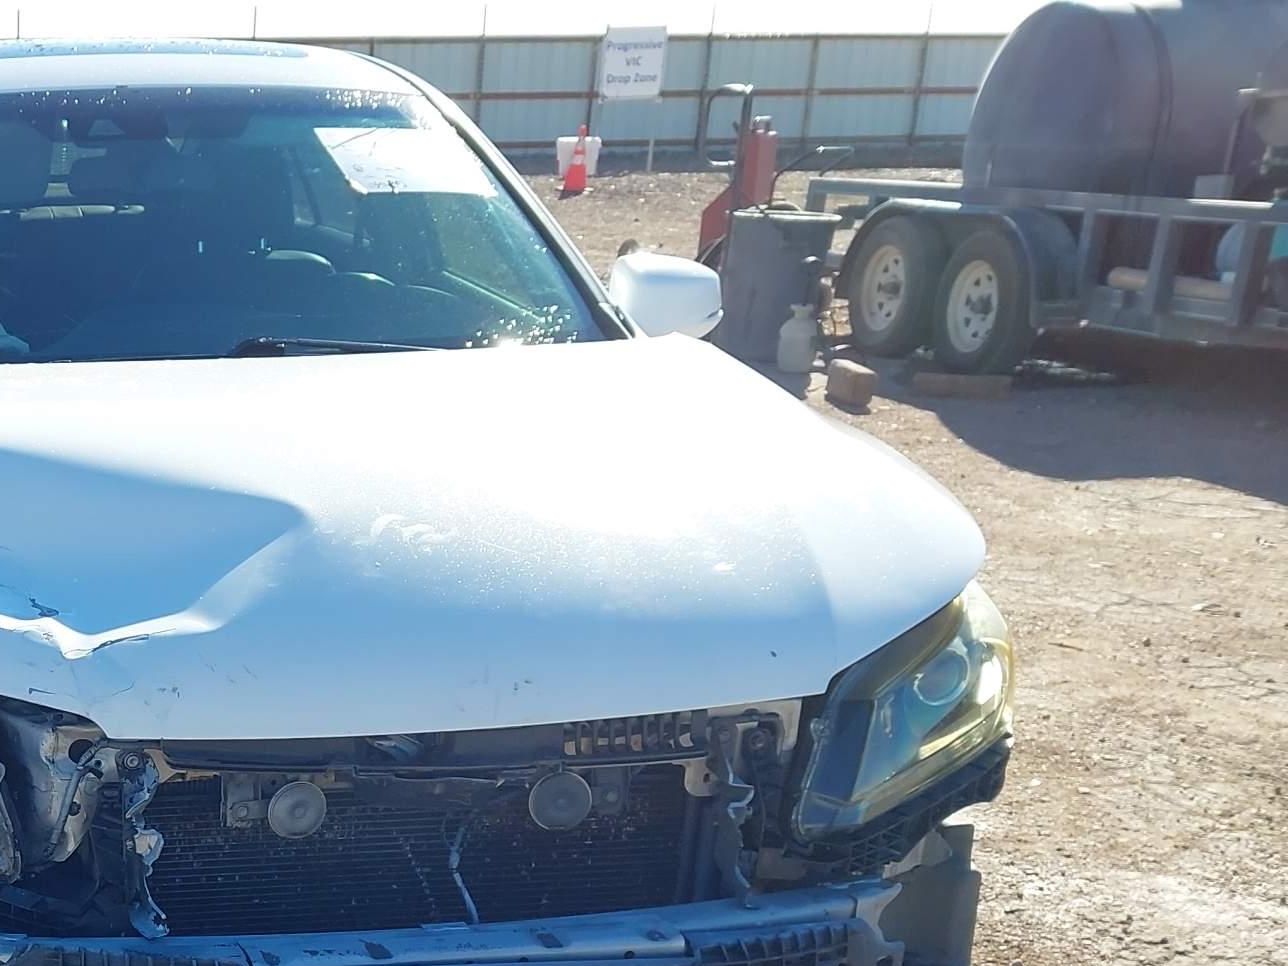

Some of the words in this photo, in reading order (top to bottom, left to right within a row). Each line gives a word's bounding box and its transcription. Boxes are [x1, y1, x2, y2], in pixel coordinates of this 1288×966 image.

[607, 41, 663, 52] Progressive
[625, 56, 643, 66] VIC
[607, 73, 631, 84] Drop
[634, 73, 657, 82] Zone
